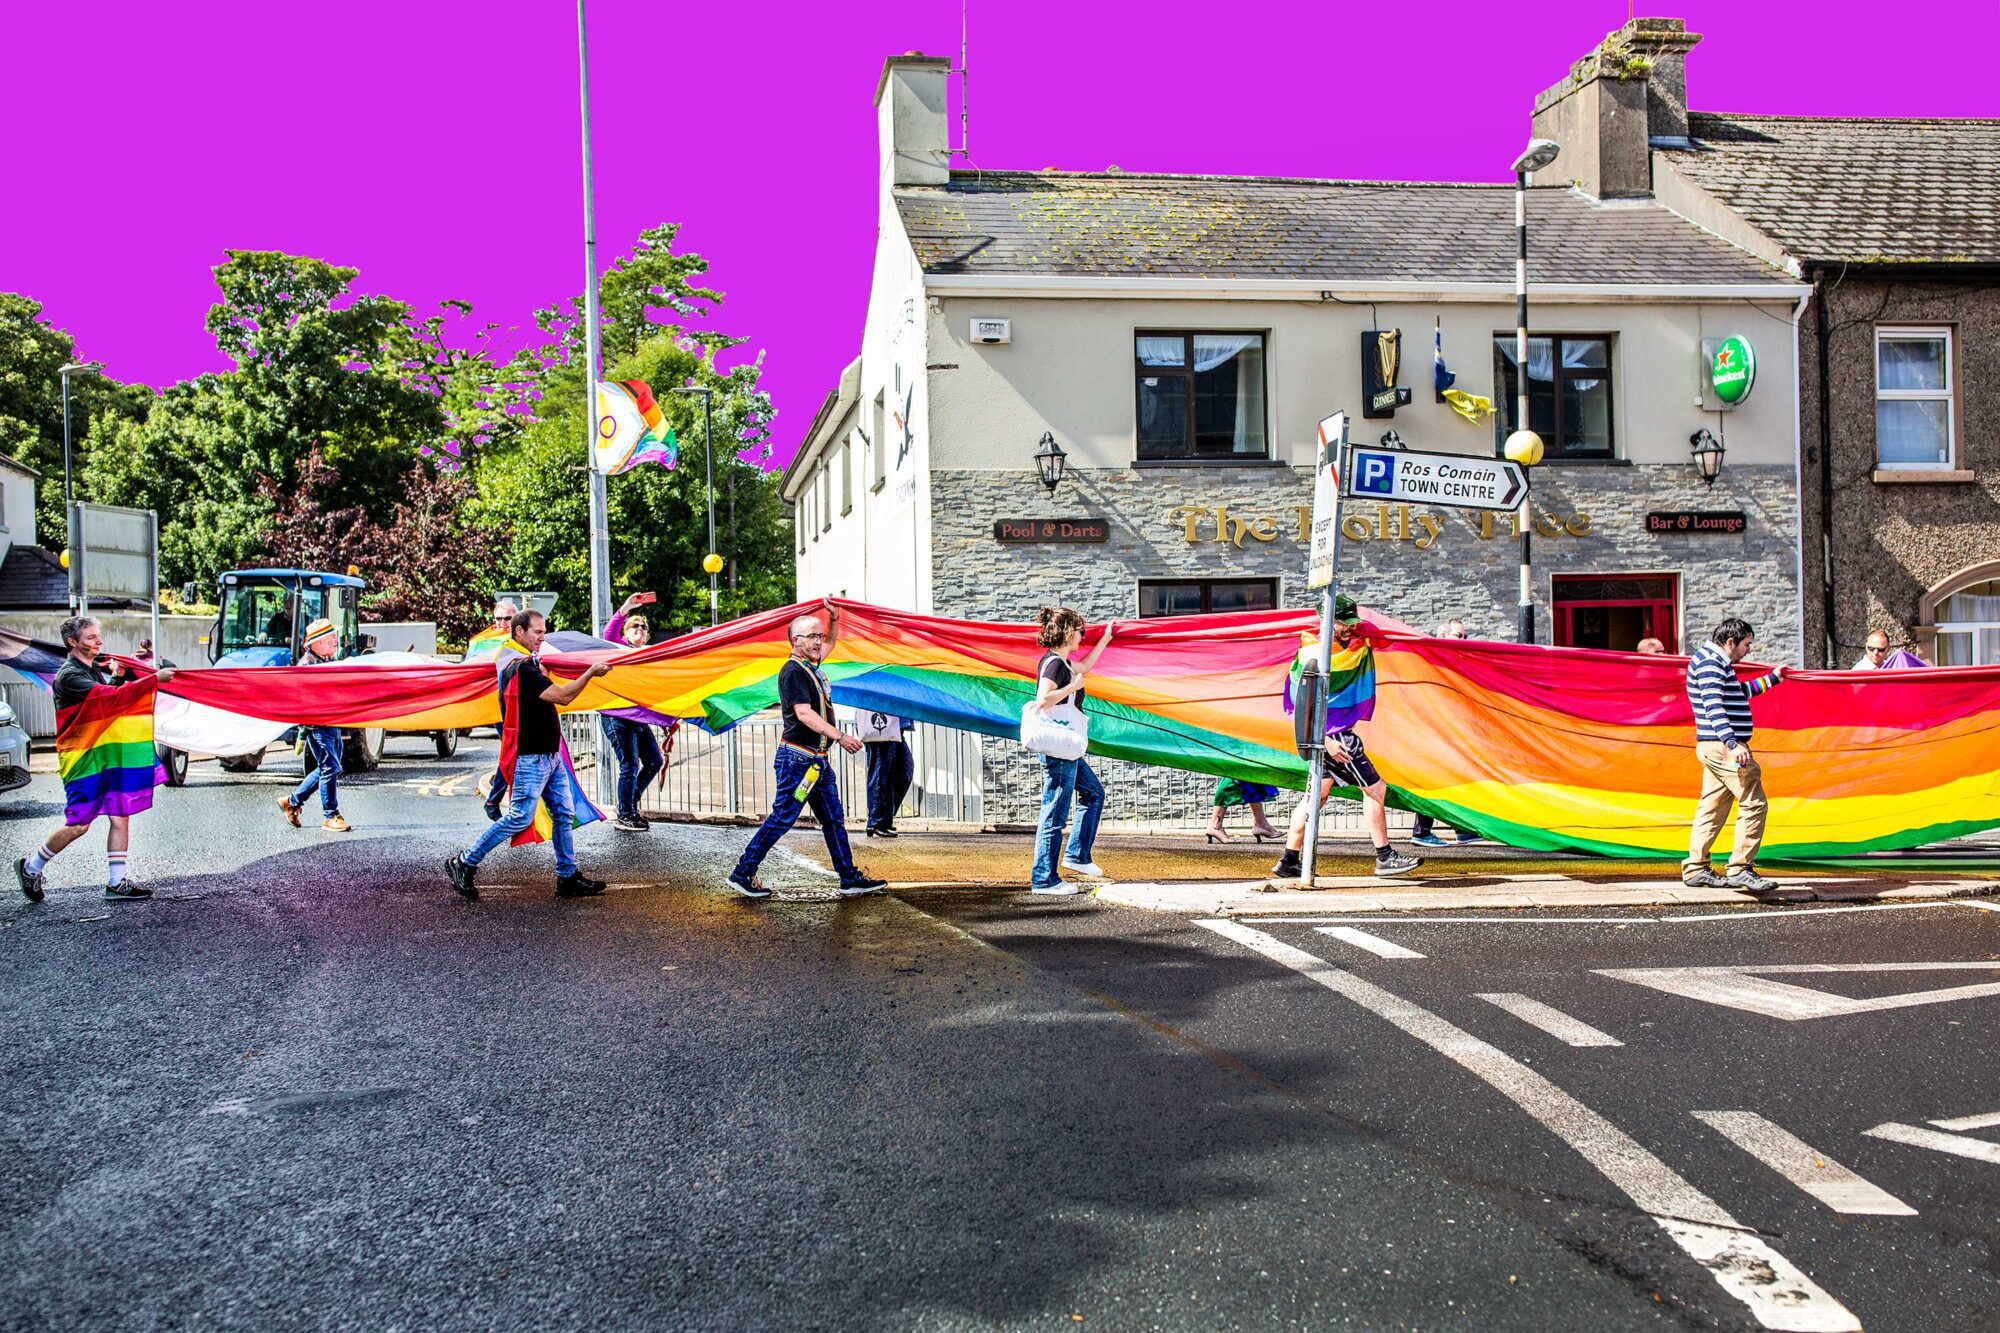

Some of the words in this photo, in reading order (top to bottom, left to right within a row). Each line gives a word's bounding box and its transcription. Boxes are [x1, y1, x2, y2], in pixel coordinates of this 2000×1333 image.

[1373, 391, 1395, 409] GUINNESS
[1401, 461, 1430, 475] Ros
[1438, 464, 1496, 482] Comáin
[1401, 479, 1439, 494] TOWN
[1443, 482, 1495, 500] CENTRE
[1002, 522, 1035, 537] Pool
[1042, 523, 1056, 537] &
[1060, 523, 1103, 537] Darts
[1168, 505, 1279, 549] The
[1315, 517, 1332, 534] EXCEPT
[1650, 516, 1674, 529] Bar
[1677, 515, 1690, 528] &
[1693, 515, 1743, 532] Lounge
[1317, 537, 1327, 551] FOR
